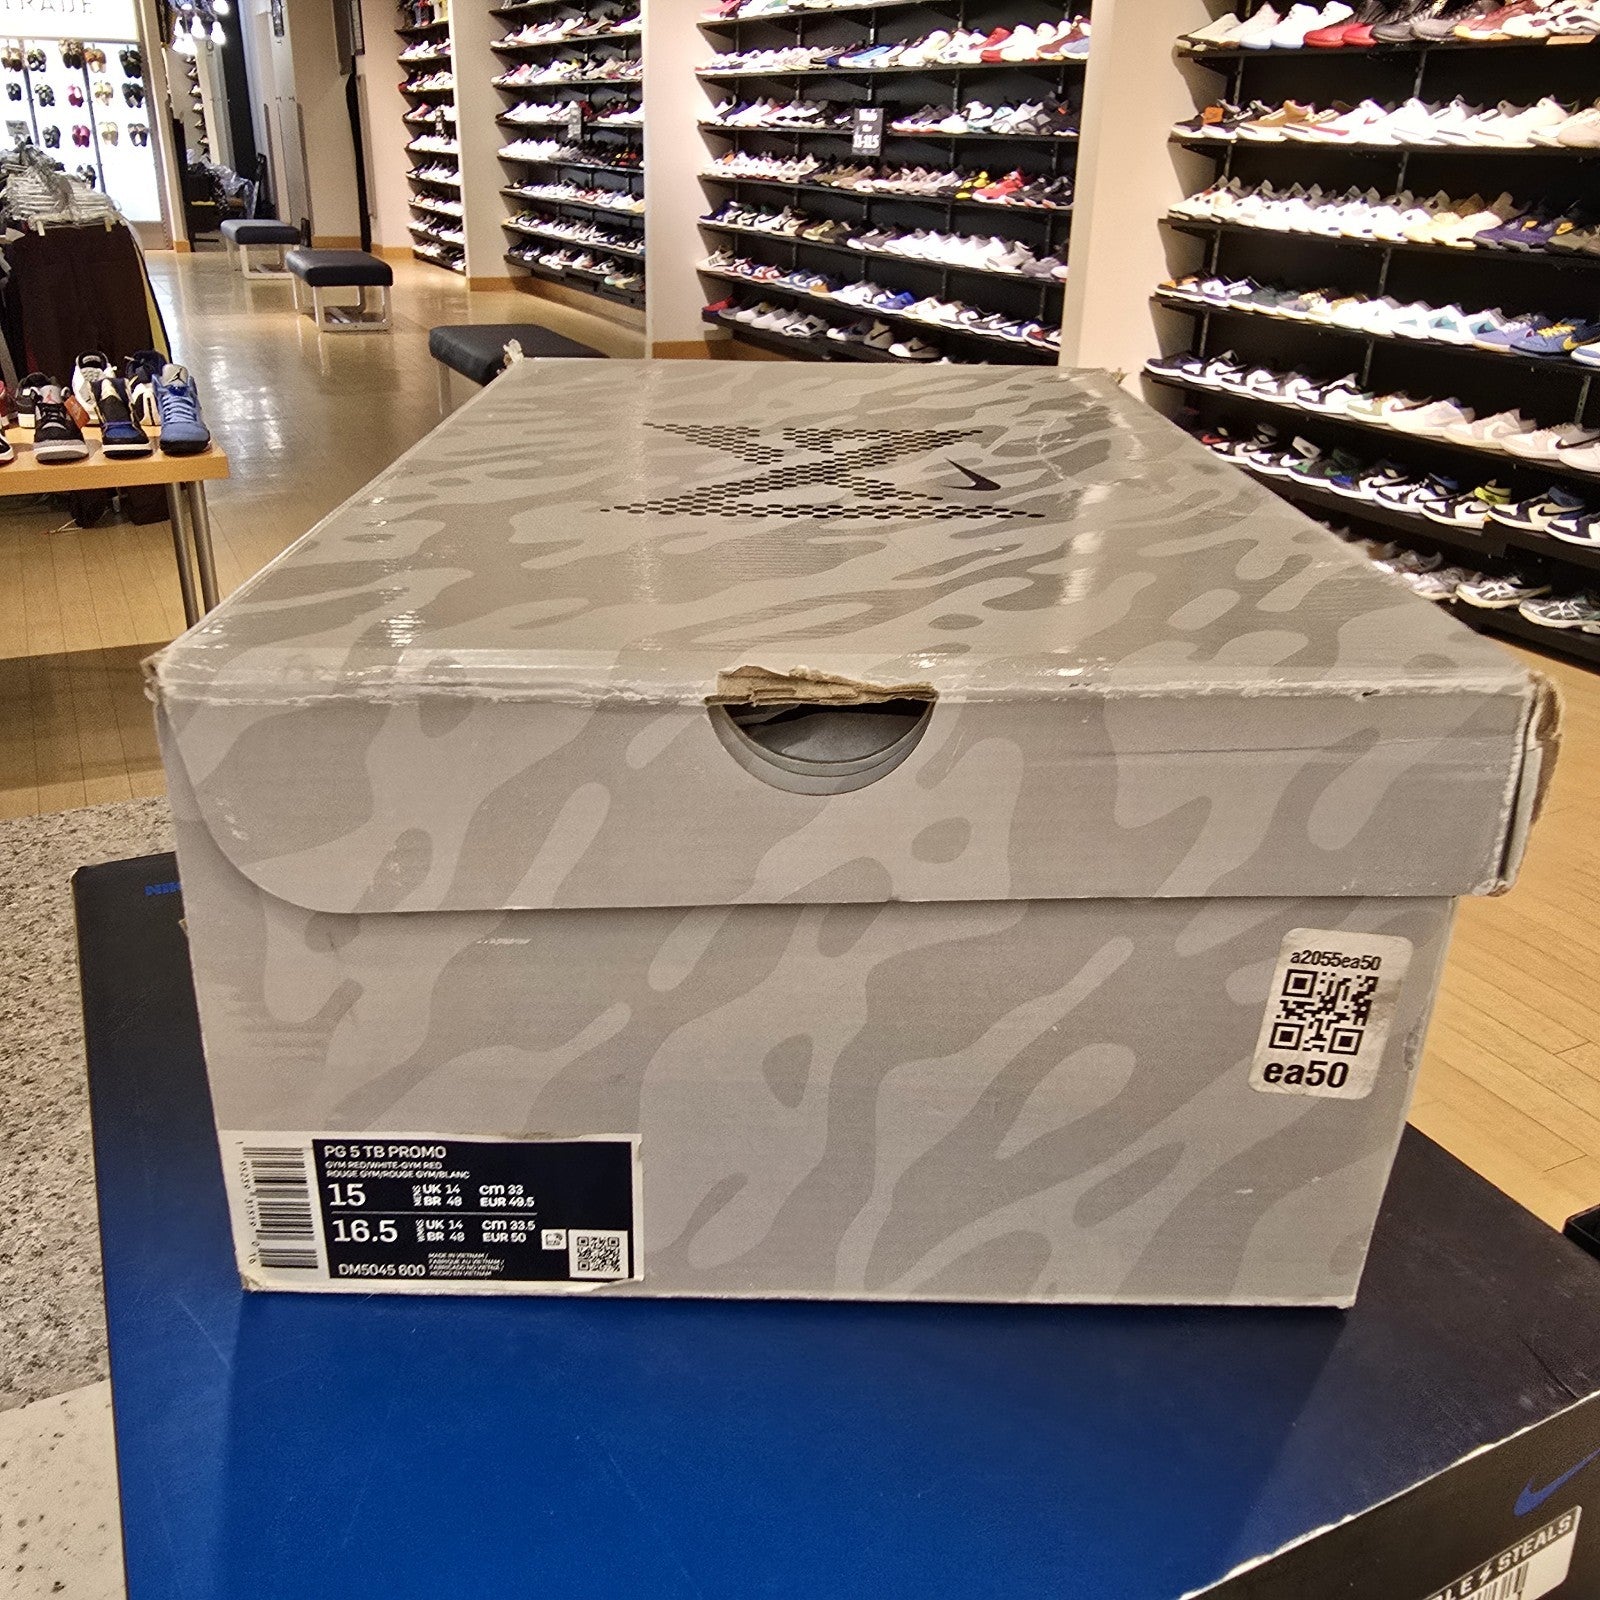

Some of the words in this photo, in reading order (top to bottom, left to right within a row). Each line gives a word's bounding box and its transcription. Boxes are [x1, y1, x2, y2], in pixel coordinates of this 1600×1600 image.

[1290, 949, 1382, 971] a2055ea50
[1263, 1059, 1350, 1089] ea50
[324, 1145, 346, 1158] PG
[350, 1145, 360, 1158] 5
[362, 1145, 386, 1158] TB
[388, 1145, 447, 1159] PROMO
[325, 1161, 347, 1169] GYM
[423, 1161, 443, 1170] RED
[326, 1170, 358, 1178] ROUGE
[327, 1183, 366, 1206] 15
[422, 1184, 442, 1194] UK
[445, 1184, 460, 1194] 14
[479, 1184, 505, 1195] cm
[507, 1184, 524, 1195] 33
[423, 1196, 442, 1206] BR
[479, 1196, 507, 1207] EUR
[425, 1219, 445, 1230] UK
[448, 1219, 464, 1230] 14
[481, 1219, 507, 1231] cm
[509, 1220, 536, 1231] 33.5
[332, 1219, 398, 1242] 16.5
[426, 1231, 445, 1241] BR
[482, 1232, 509, 1243] EUR
[510, 1232, 527, 1243] 50
[338, 1263, 396, 1276] DM5045
[1432, 1575, 1475, 1600] LE
[1497, 1515, 1572, 1572] STEALS
